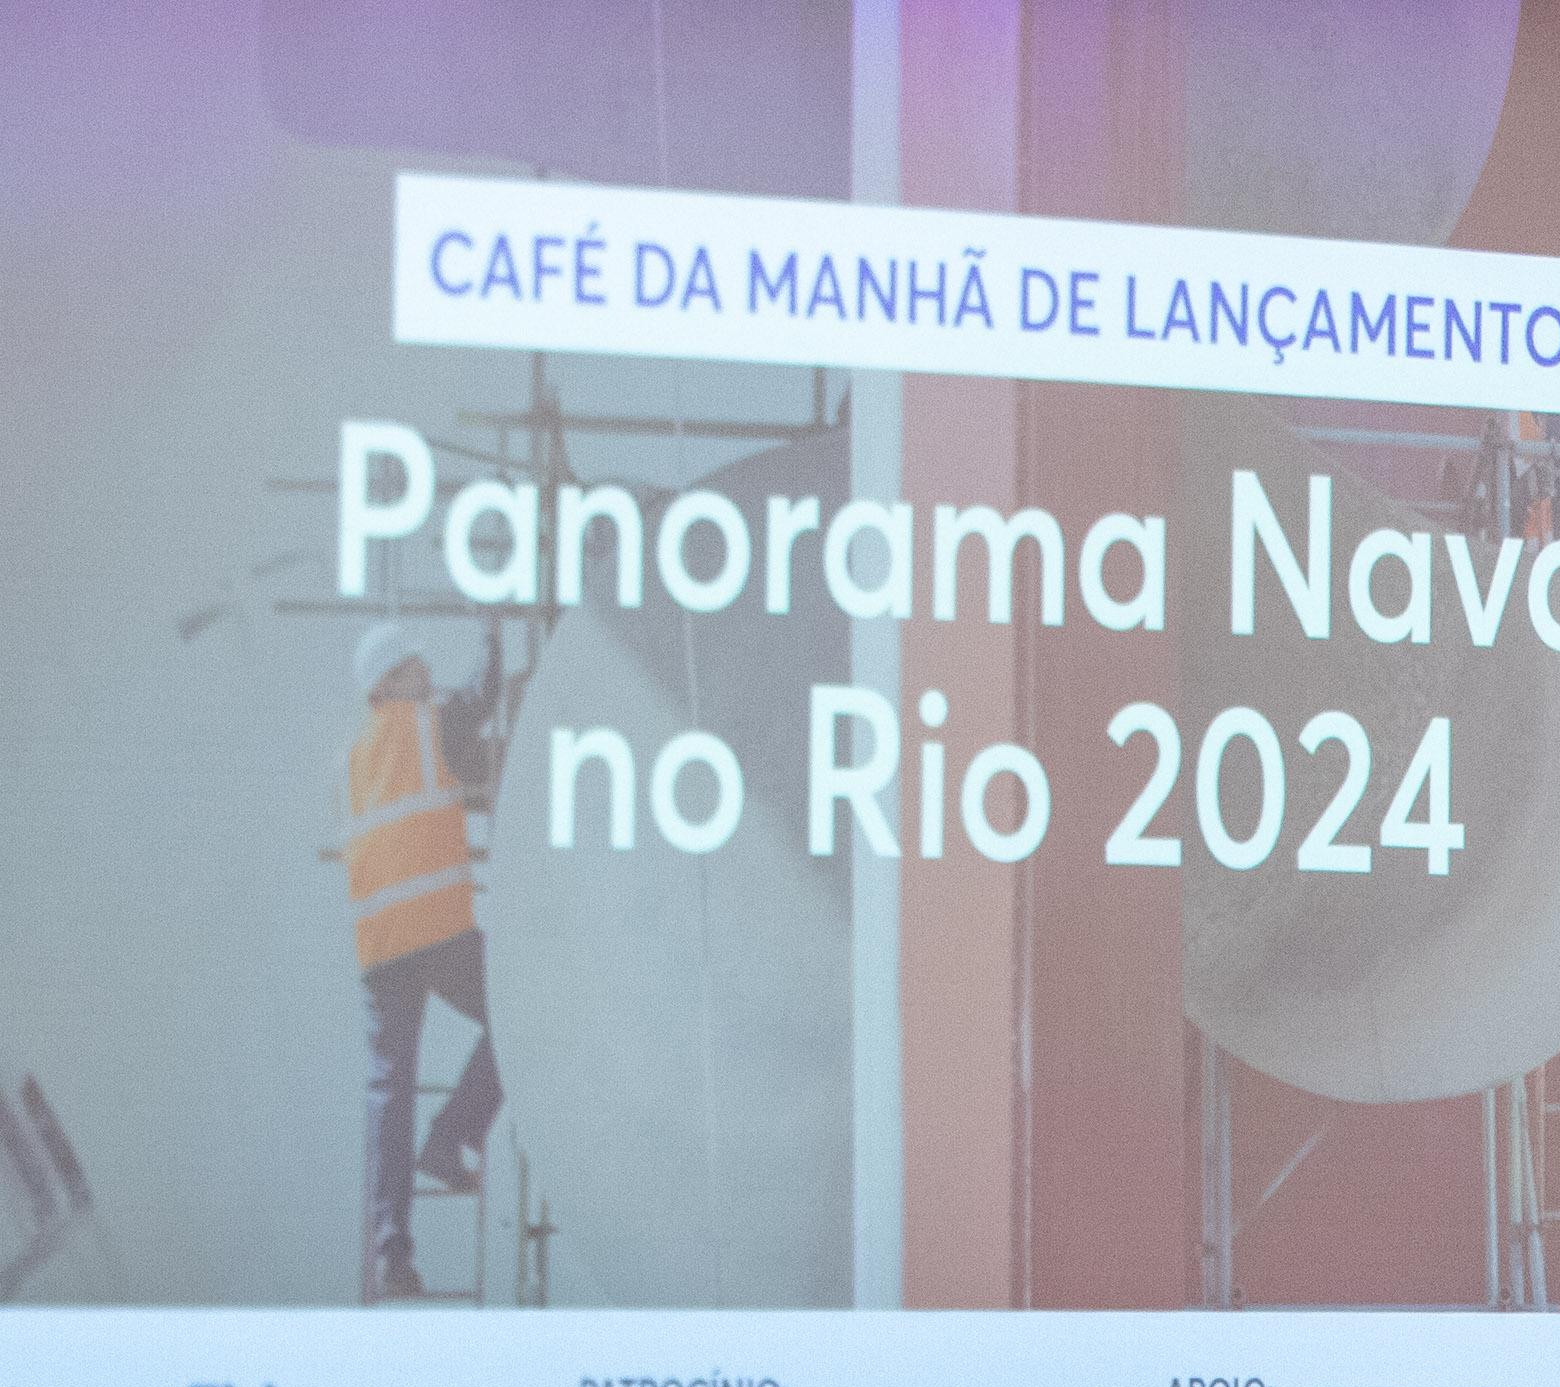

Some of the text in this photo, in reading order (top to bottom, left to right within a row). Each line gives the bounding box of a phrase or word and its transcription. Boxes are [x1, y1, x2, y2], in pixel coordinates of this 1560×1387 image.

[428, 222, 606, 304] CAFÉ
[633, 242, 721, 312] DA
[747, 247, 994, 329] MANHÃ
[1018, 268, 1100, 336] DE
[336, 418, 1167, 632] Panorama
[547, 683, 1465, 876] no Rio 2024
